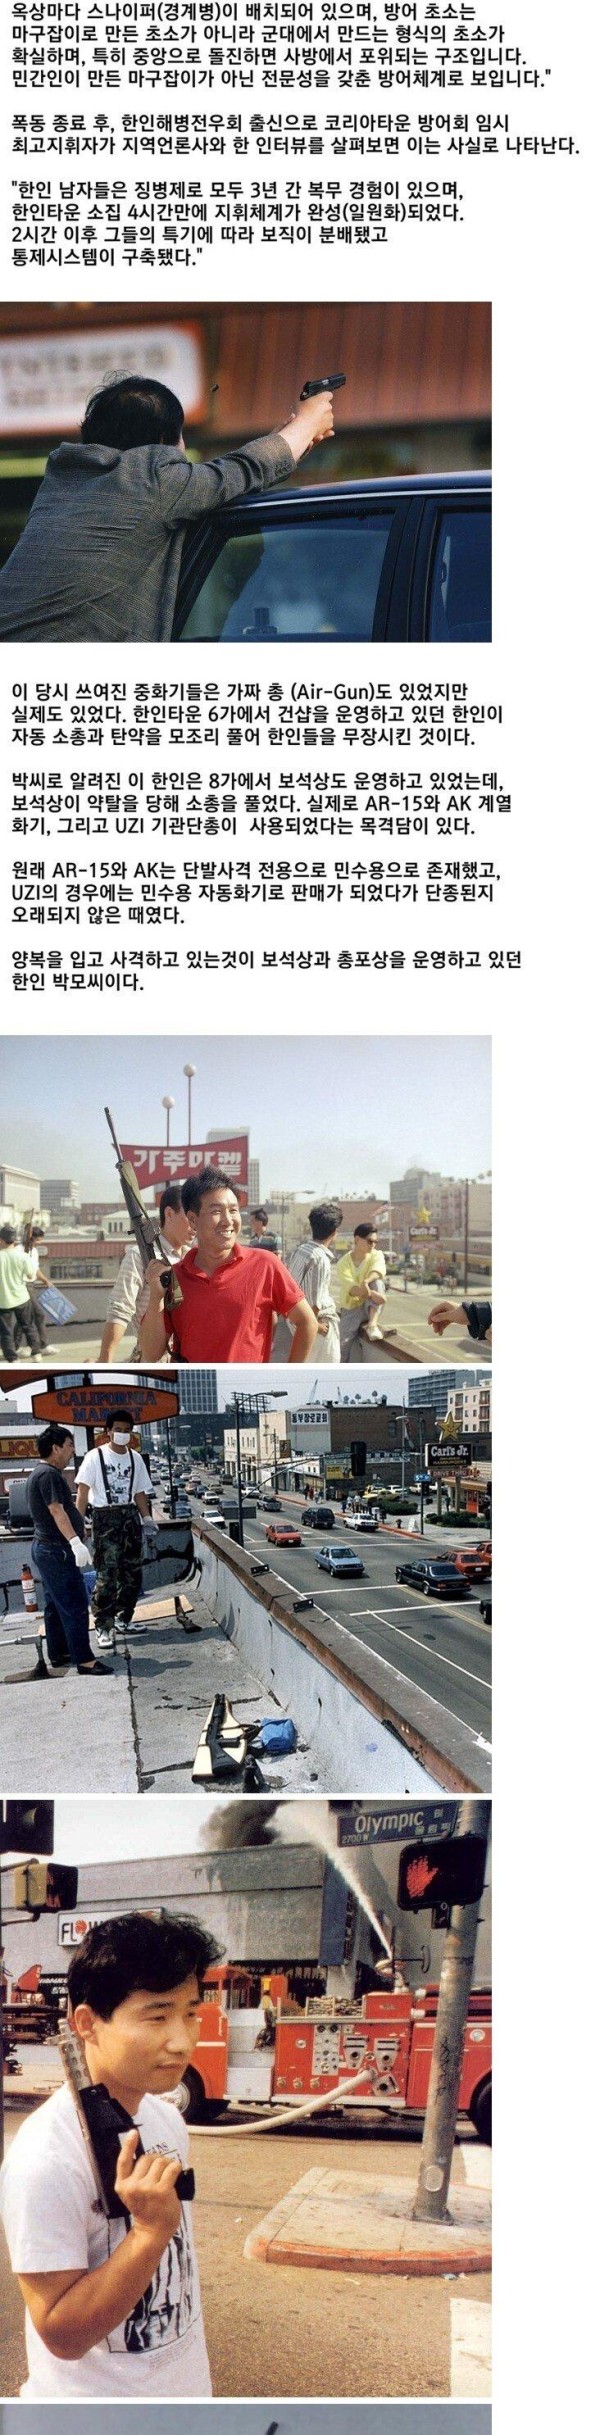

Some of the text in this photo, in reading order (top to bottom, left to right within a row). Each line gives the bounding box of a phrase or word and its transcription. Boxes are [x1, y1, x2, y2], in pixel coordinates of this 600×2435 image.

[56, 1391, 157, 1407] CALIFORNIA
[72, 1407, 143, 1423] MART
[292, 1412, 328, 1423] 동부장로교회
[431, 1445, 469, 1456] Carl's Jr.
[354, 1811, 424, 1835] Olympic
[341, 1834, 362, 1845] 2700
